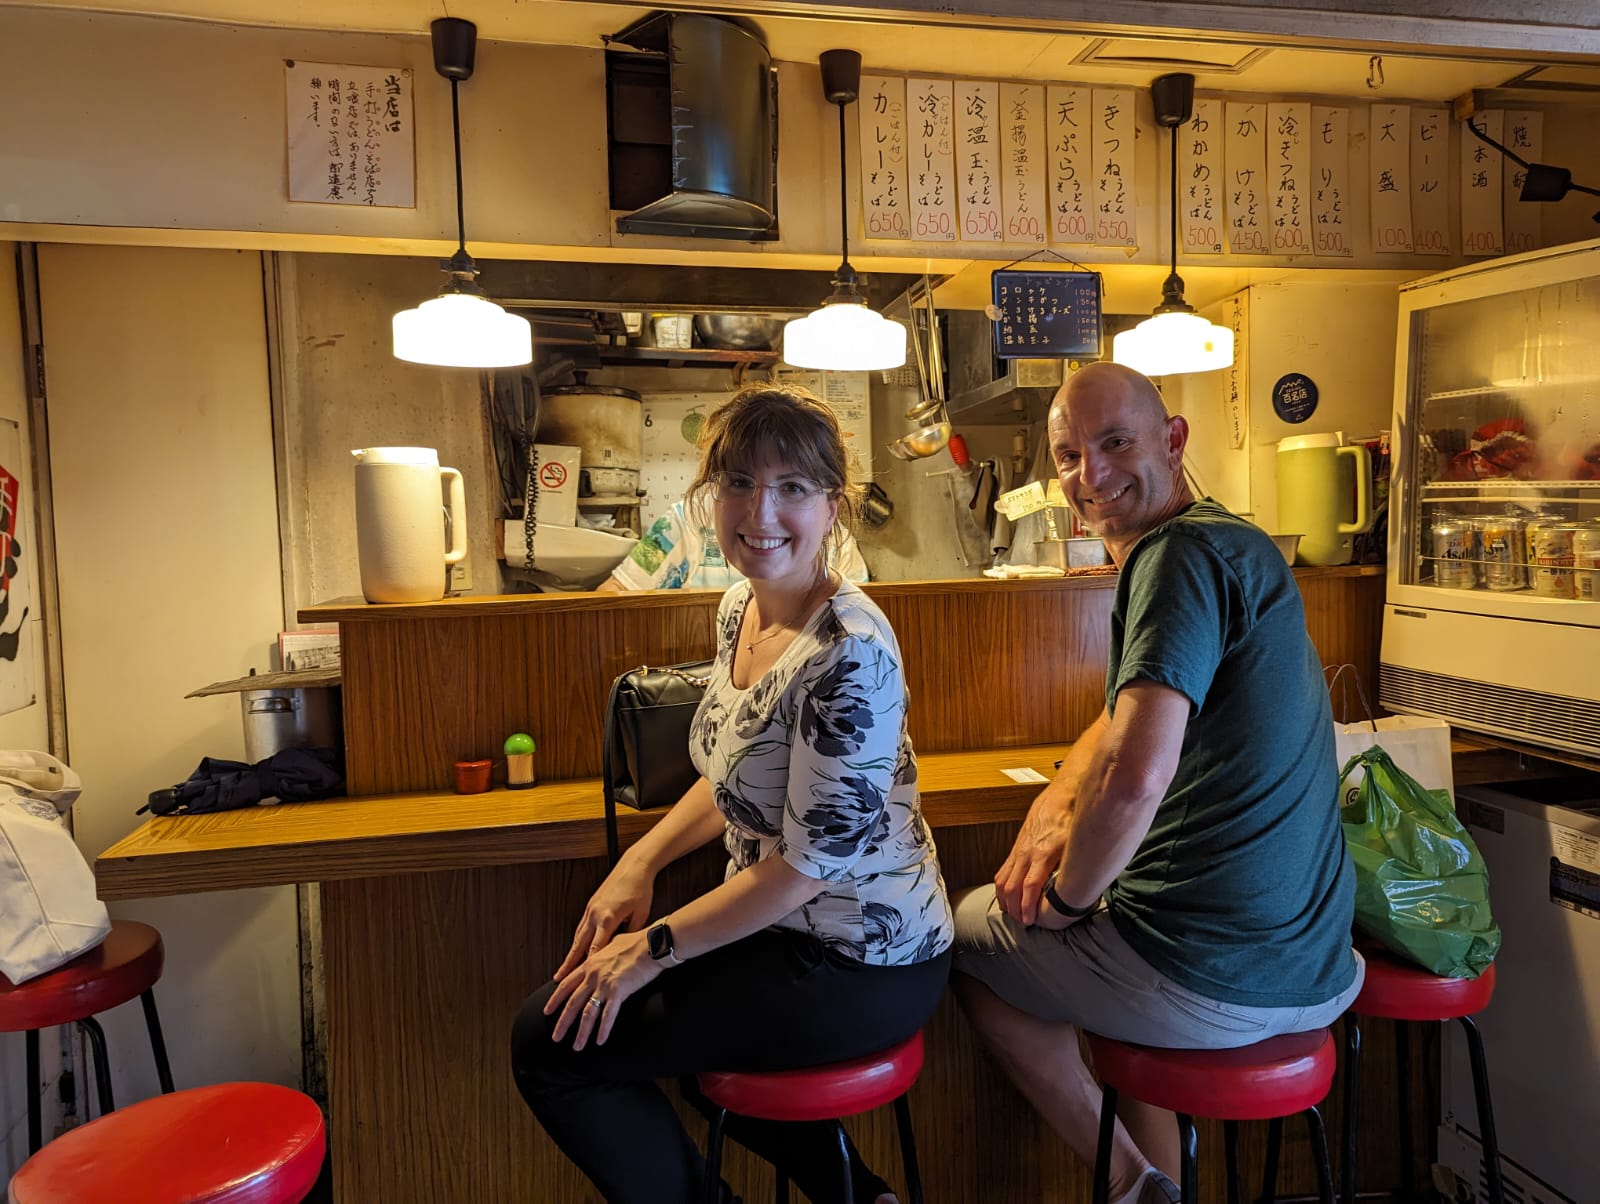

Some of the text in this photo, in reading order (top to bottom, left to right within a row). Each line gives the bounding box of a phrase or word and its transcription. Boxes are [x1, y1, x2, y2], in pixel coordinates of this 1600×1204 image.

[382, 74, 401, 133] 当店は
[873, 93, 888, 169] カレー
[1056, 100, 1077, 182] 天ぷら
[1103, 105, 1121, 177] きつね
[1192, 113, 1210, 182] わかめ
[1237, 119, 1258, 187] かけ
[1321, 123, 1334, 187] もり
[1379, 122, 1398, 192] 大盛
[1420, 122, 1439, 193] ビール
[870, 173, 881, 207] そば
[887, 172, 898, 207] うどん
[918, 174, 929, 206] そば
[934, 172, 944, 207] うどん
[967, 173, 978, 205] そば
[982, 172, 991, 206] うどん
[1057, 181, 1068, 213] そば
[1071, 180, 1083, 214] うどん
[1099, 180, 1110, 213] そば
[1115, 180, 1124, 214] うどん
[1189, 185, 1200, 218] そば
[1203, 183, 1212, 221] うどん
[1332, 189, 1341, 224] うどん
[1232, 192, 1244, 228] そば
[1247, 190, 1257, 227] うどん
[1275, 195, 1286, 227] そば
[1291, 193, 1300, 227] うどん
[1316, 190, 1329, 224] そば
[1001, 286, 1046, 295] コロッケ
[644, 413, 653, 427] 6
